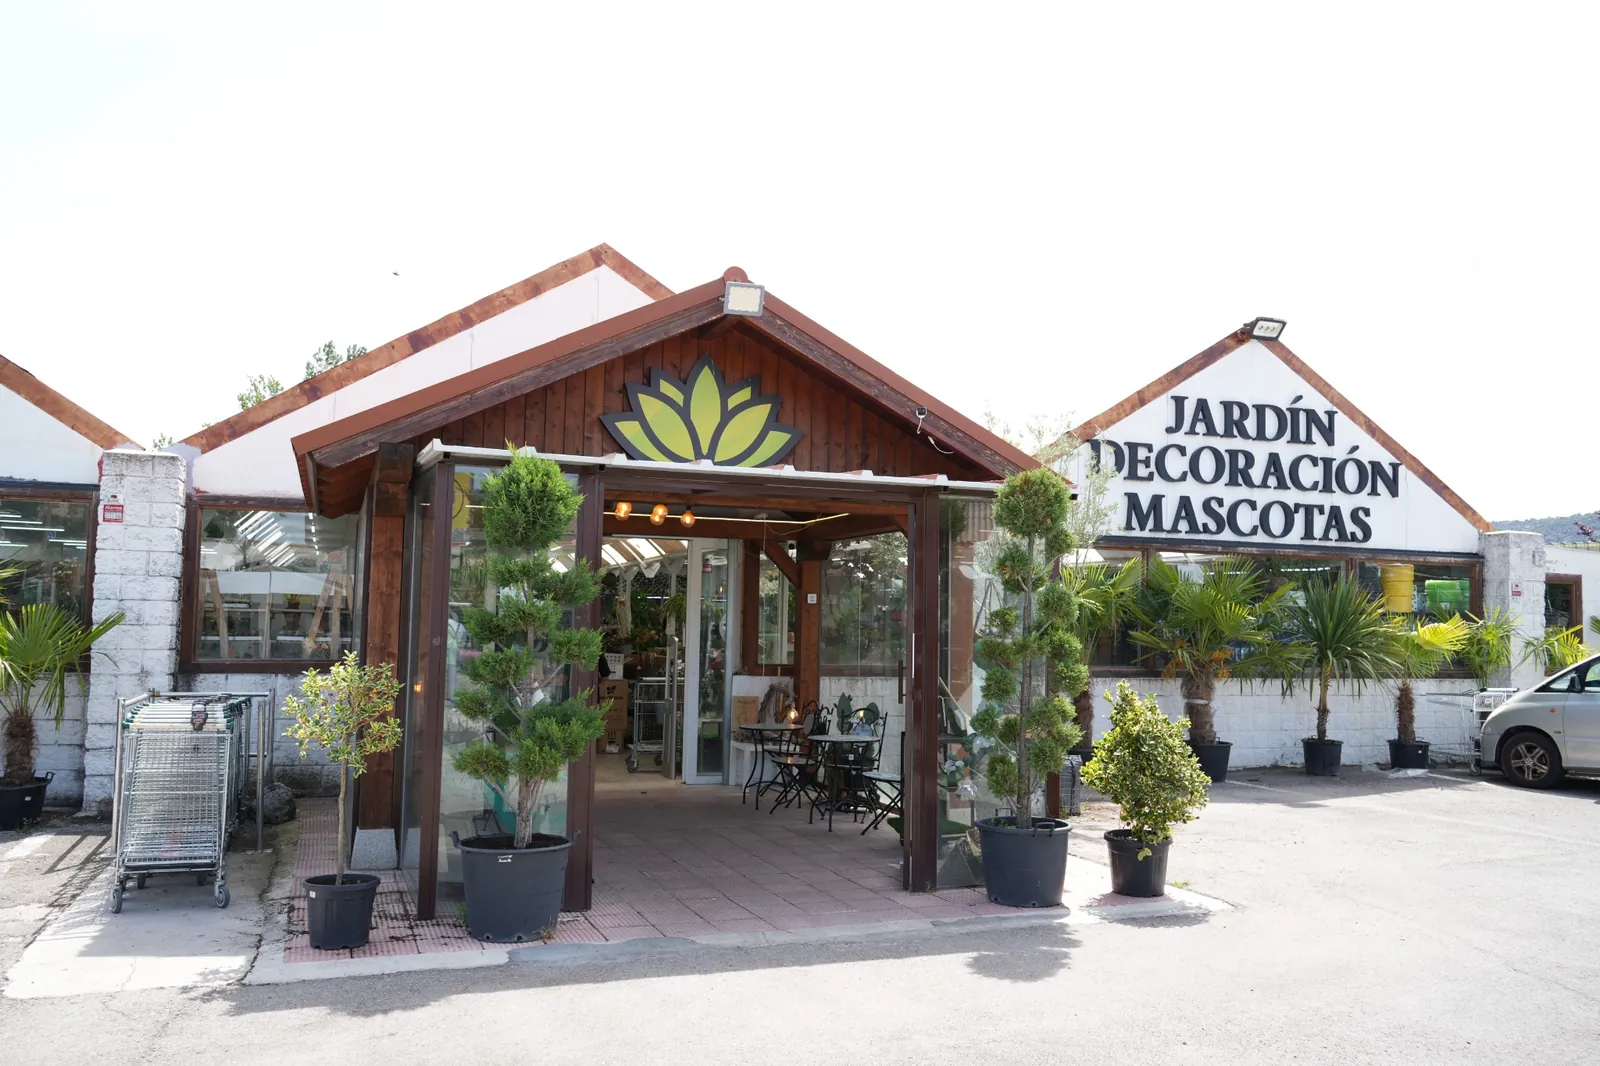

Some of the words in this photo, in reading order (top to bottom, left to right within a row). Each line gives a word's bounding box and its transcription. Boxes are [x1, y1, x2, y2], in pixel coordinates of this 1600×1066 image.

[1165, 395, 1338, 446] JARDÍN
[1088, 439, 1402, 498] DECORACIÓN
[1124, 492, 1373, 543] MASCOTAS
